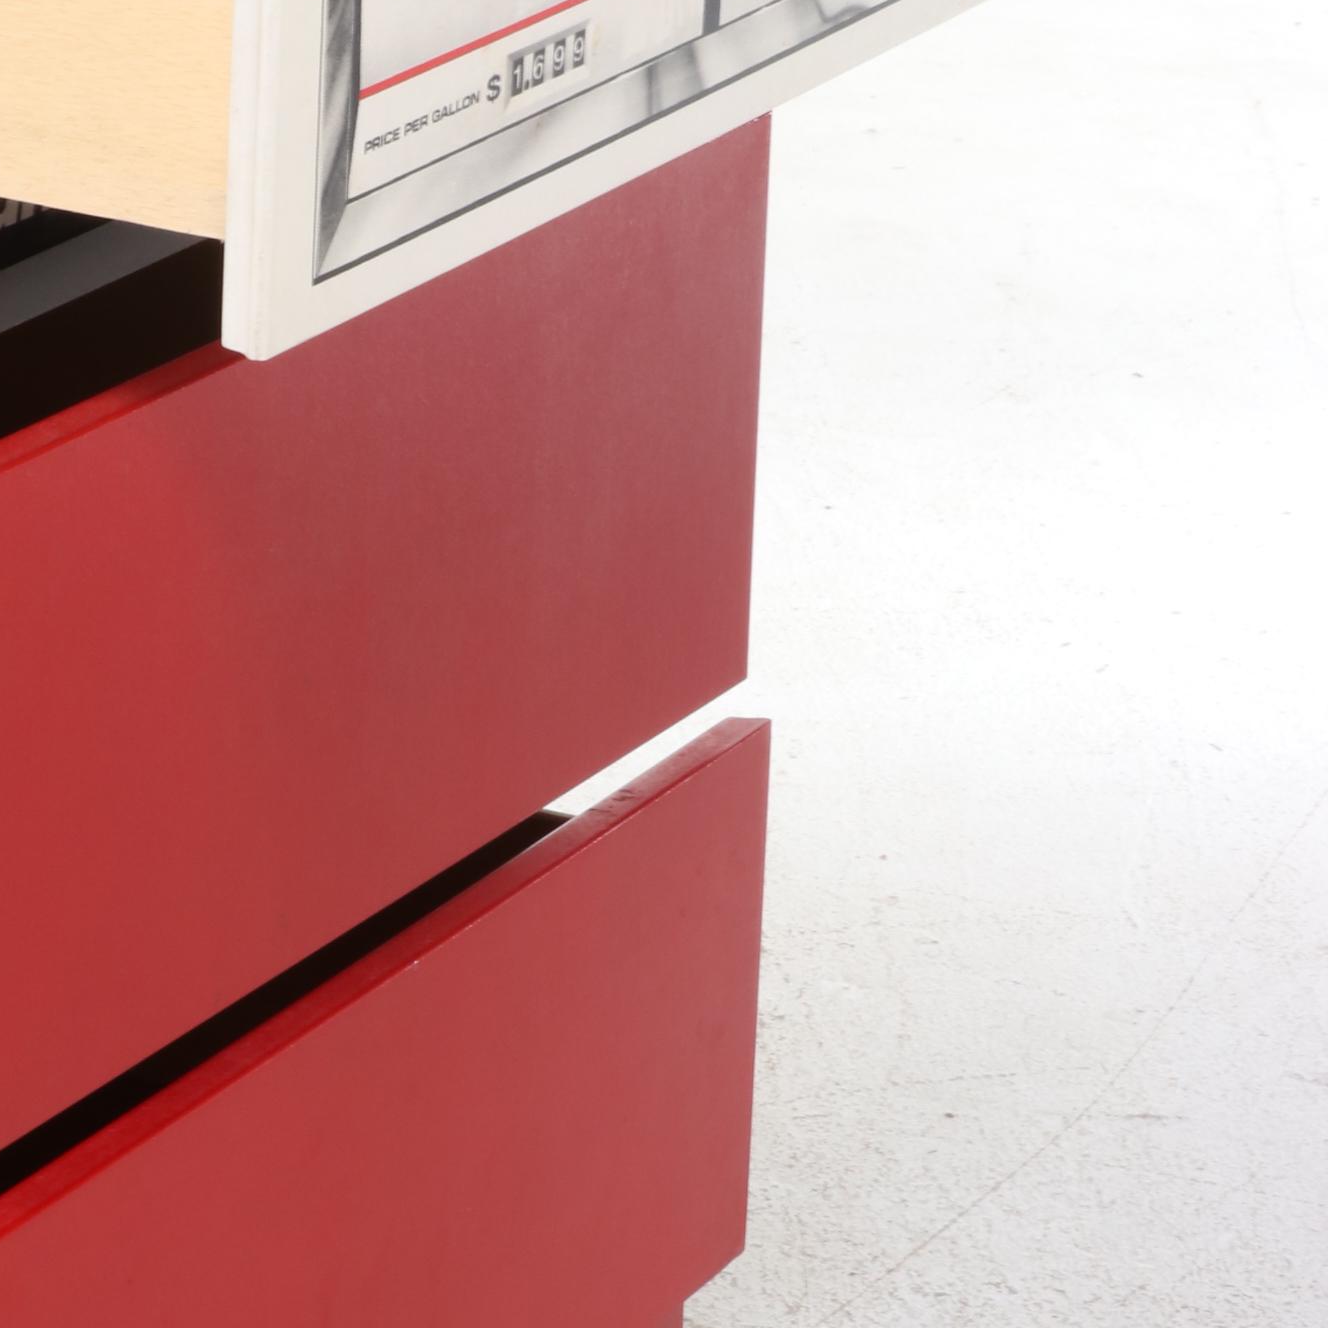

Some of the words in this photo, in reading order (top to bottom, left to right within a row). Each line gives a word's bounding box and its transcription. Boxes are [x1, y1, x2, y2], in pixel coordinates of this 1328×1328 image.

[363, 126, 401, 154] PRICE
[403, 113, 429, 136] PER
[431, 91, 481, 124] GALLON
